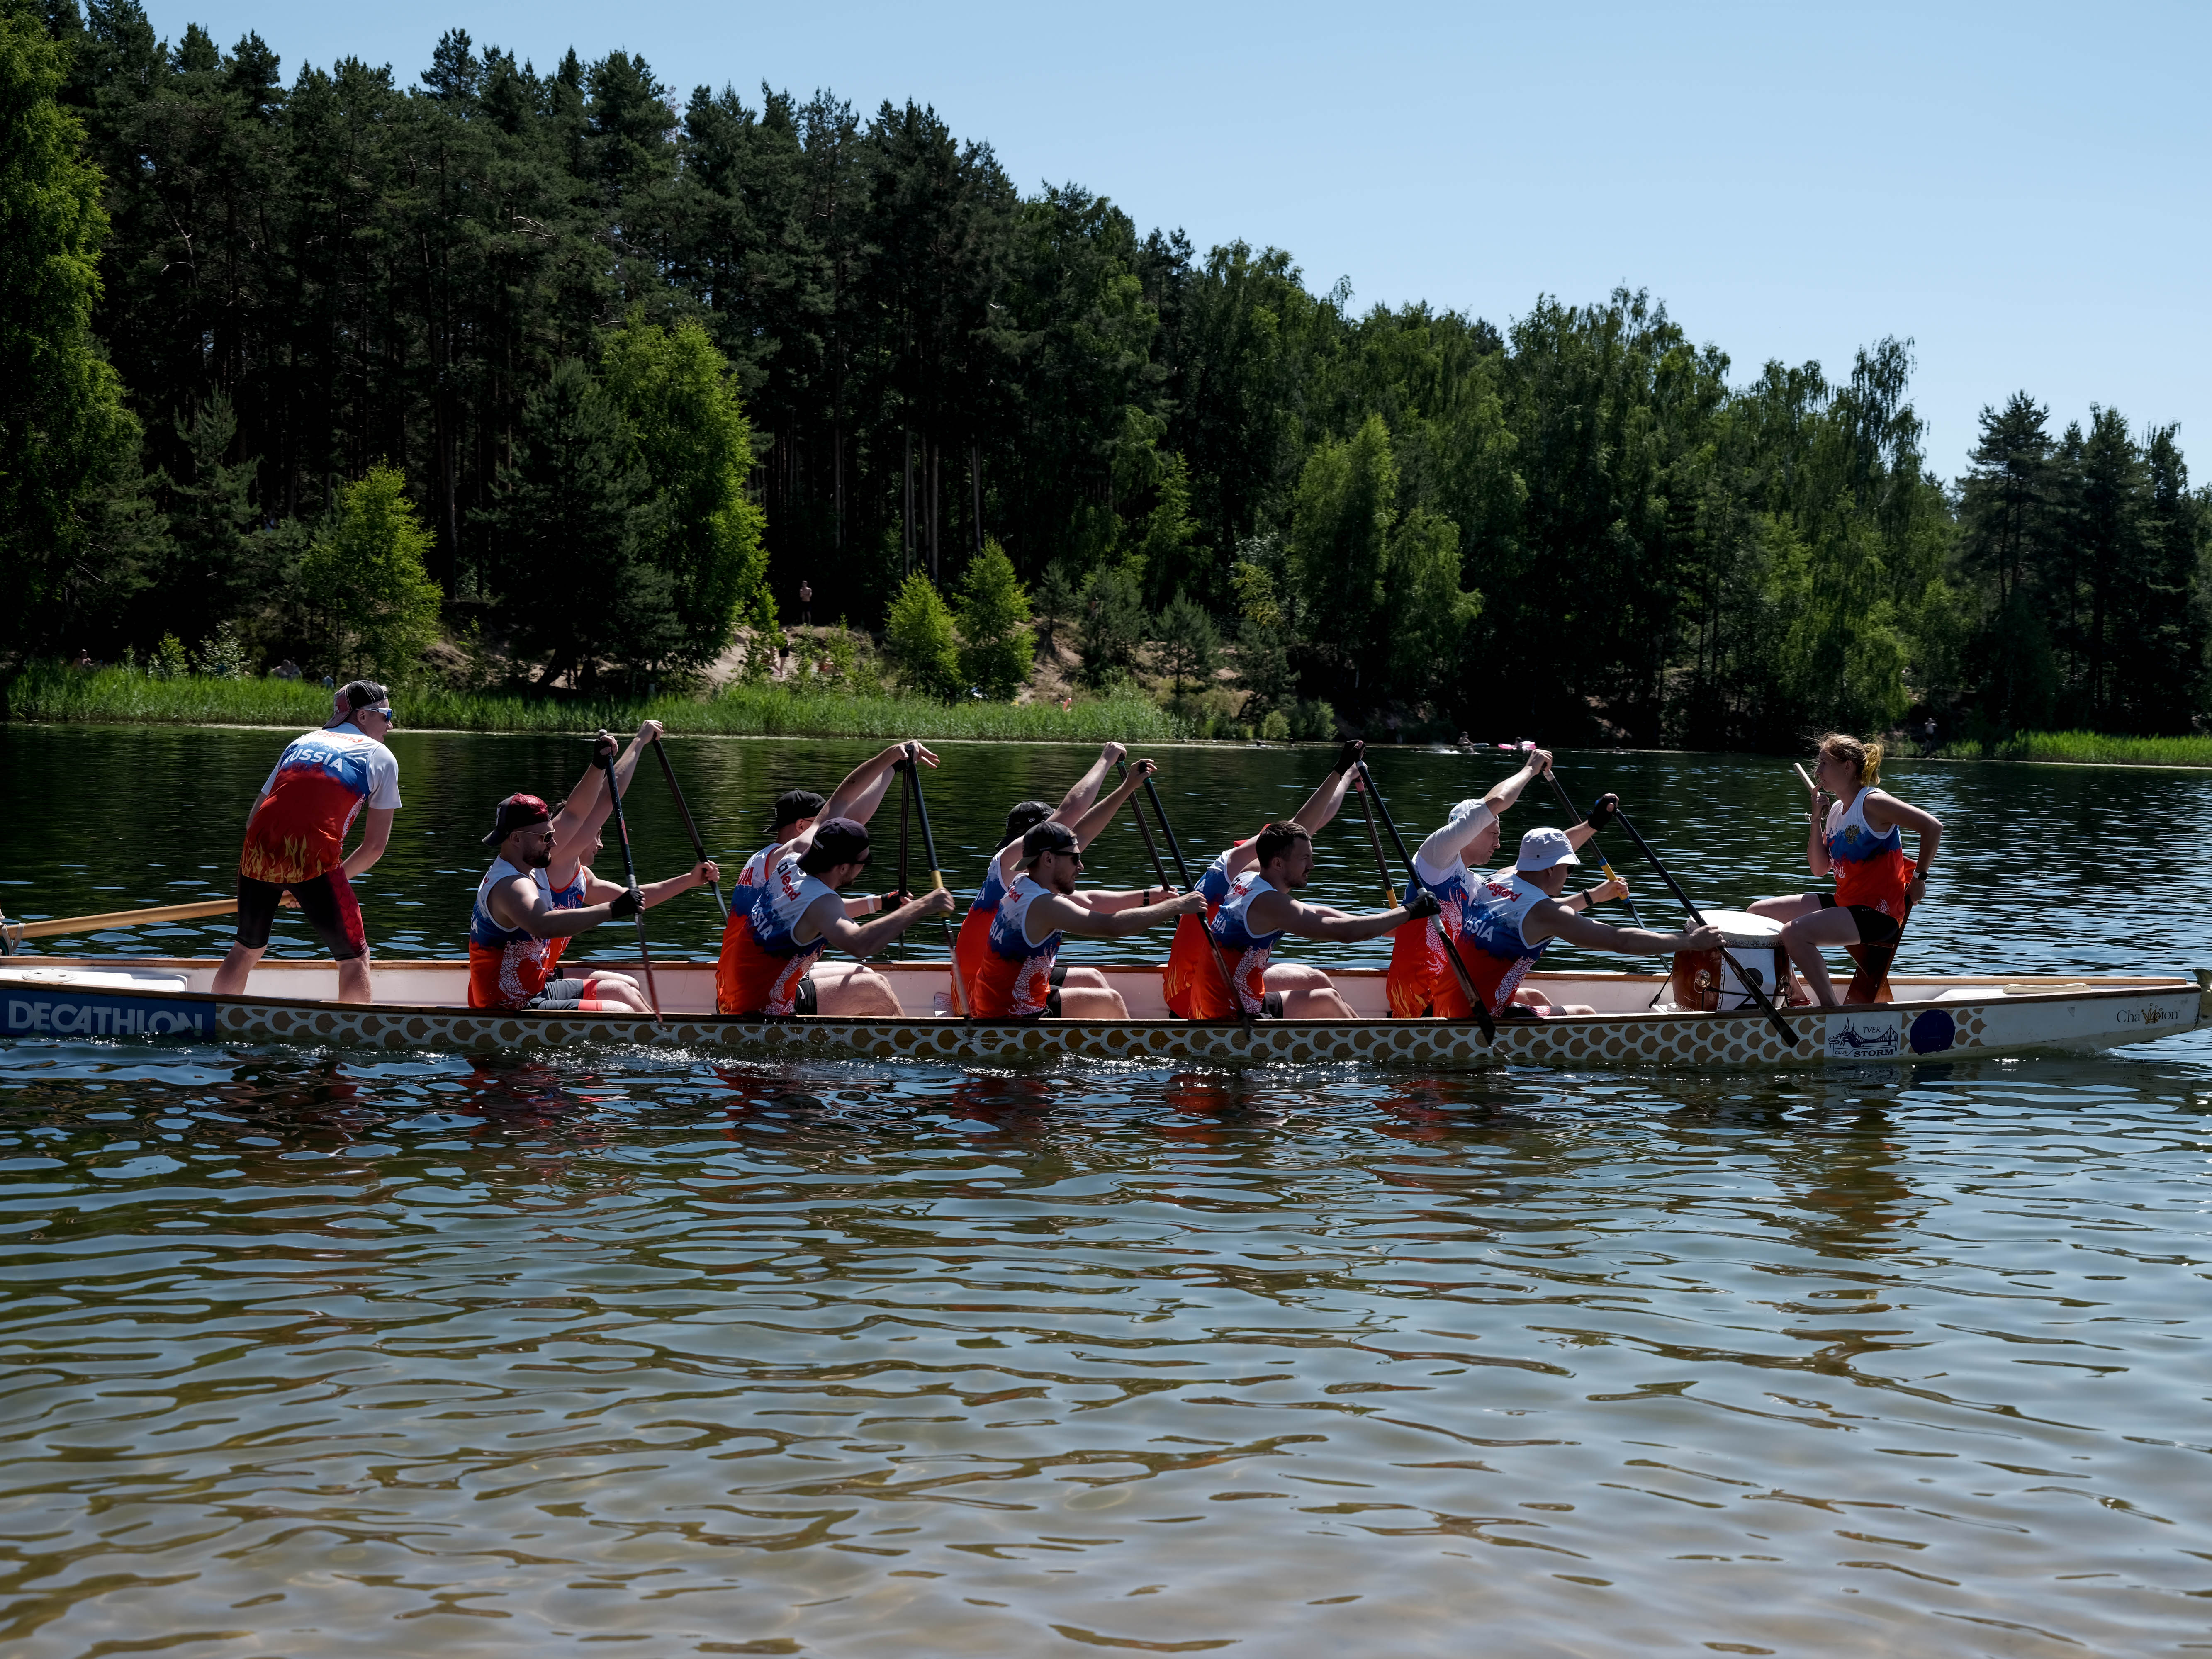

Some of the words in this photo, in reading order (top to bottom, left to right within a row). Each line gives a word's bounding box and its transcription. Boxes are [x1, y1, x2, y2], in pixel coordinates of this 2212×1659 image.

[314, 731, 364, 743] legrand
[8, 1000, 203, 1034] DECATHLON
[1854, 1048, 1894, 1057] STORM
